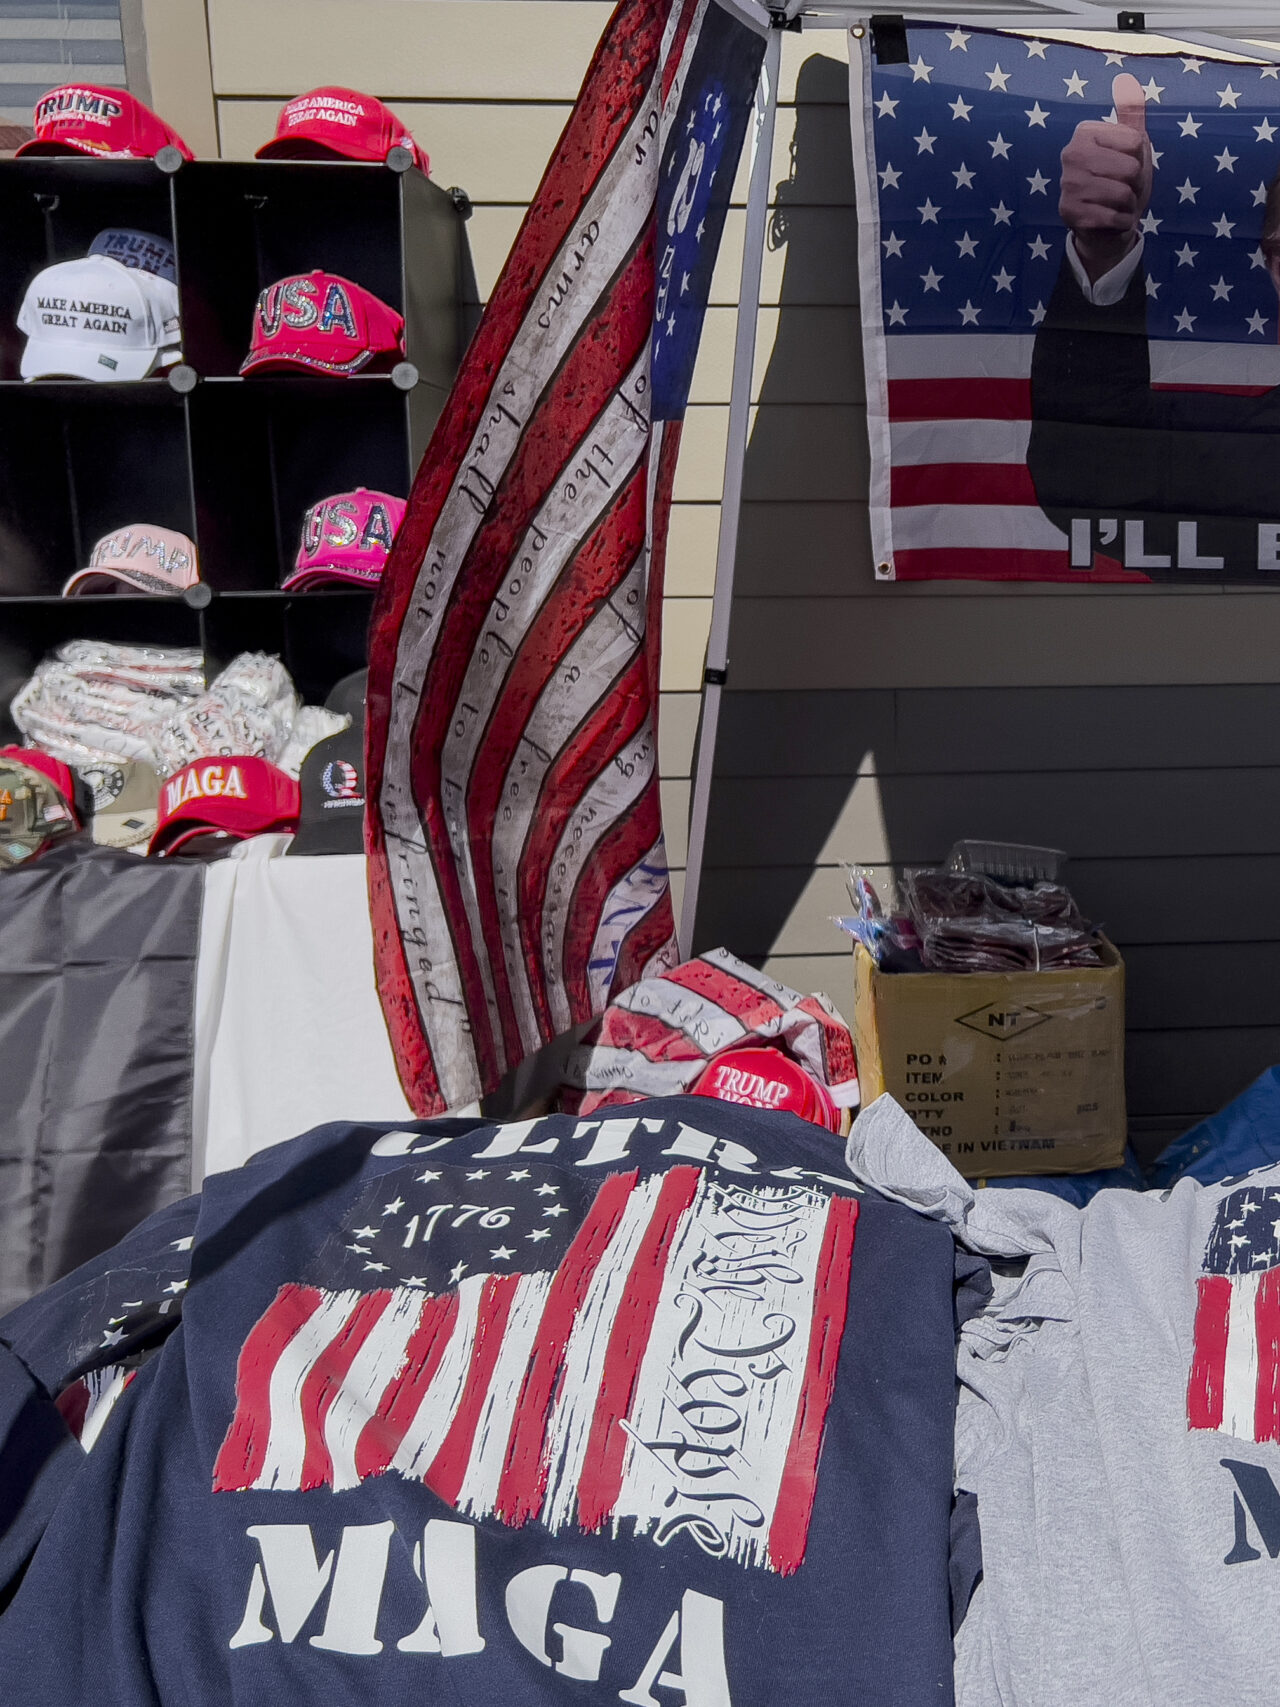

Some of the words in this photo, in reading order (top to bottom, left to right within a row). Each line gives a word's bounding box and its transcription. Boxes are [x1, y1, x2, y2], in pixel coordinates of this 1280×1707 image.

[36, 93, 123, 125] TRUMP
[309, 97, 365, 116] AMERICA
[316, 109, 358, 127] AGAIN
[538, 219, 600, 331] arms
[37, 297, 67, 309] MAKE
[70, 301, 132, 320] AMERICA
[42, 314, 78, 328] GREAT
[83, 318, 128, 335] AGAIN
[257, 279, 357, 338] USA
[618, 373, 651, 434] of
[456, 380, 522, 516] shall
[562, 441, 616, 502] the
[302, 501, 394, 557] USA
[1068, 517, 1225, 571] I'LL
[478, 522, 549, 665] people
[608, 589, 641, 643] of
[455, 703, 479, 737] to
[167, 766, 247, 816] MAGA
[502, 734, 551, 821] free
[988, 1012, 1020, 1026] NT
[713, 1065, 790, 1103] TRUMP
[906, 1054, 931, 1065] PO
[905, 1091, 964, 1102] COLOR
[370, 1116, 864, 1194] ULTR
[958, 1141, 975, 1153] IN
[980, 1138, 1056, 1152] VIETNAM
[402, 1204, 513, 1250] 1776
[692, 1238, 806, 1303] the
[618, 1290, 795, 1558] People
[228, 1519, 735, 1707] MAGA
